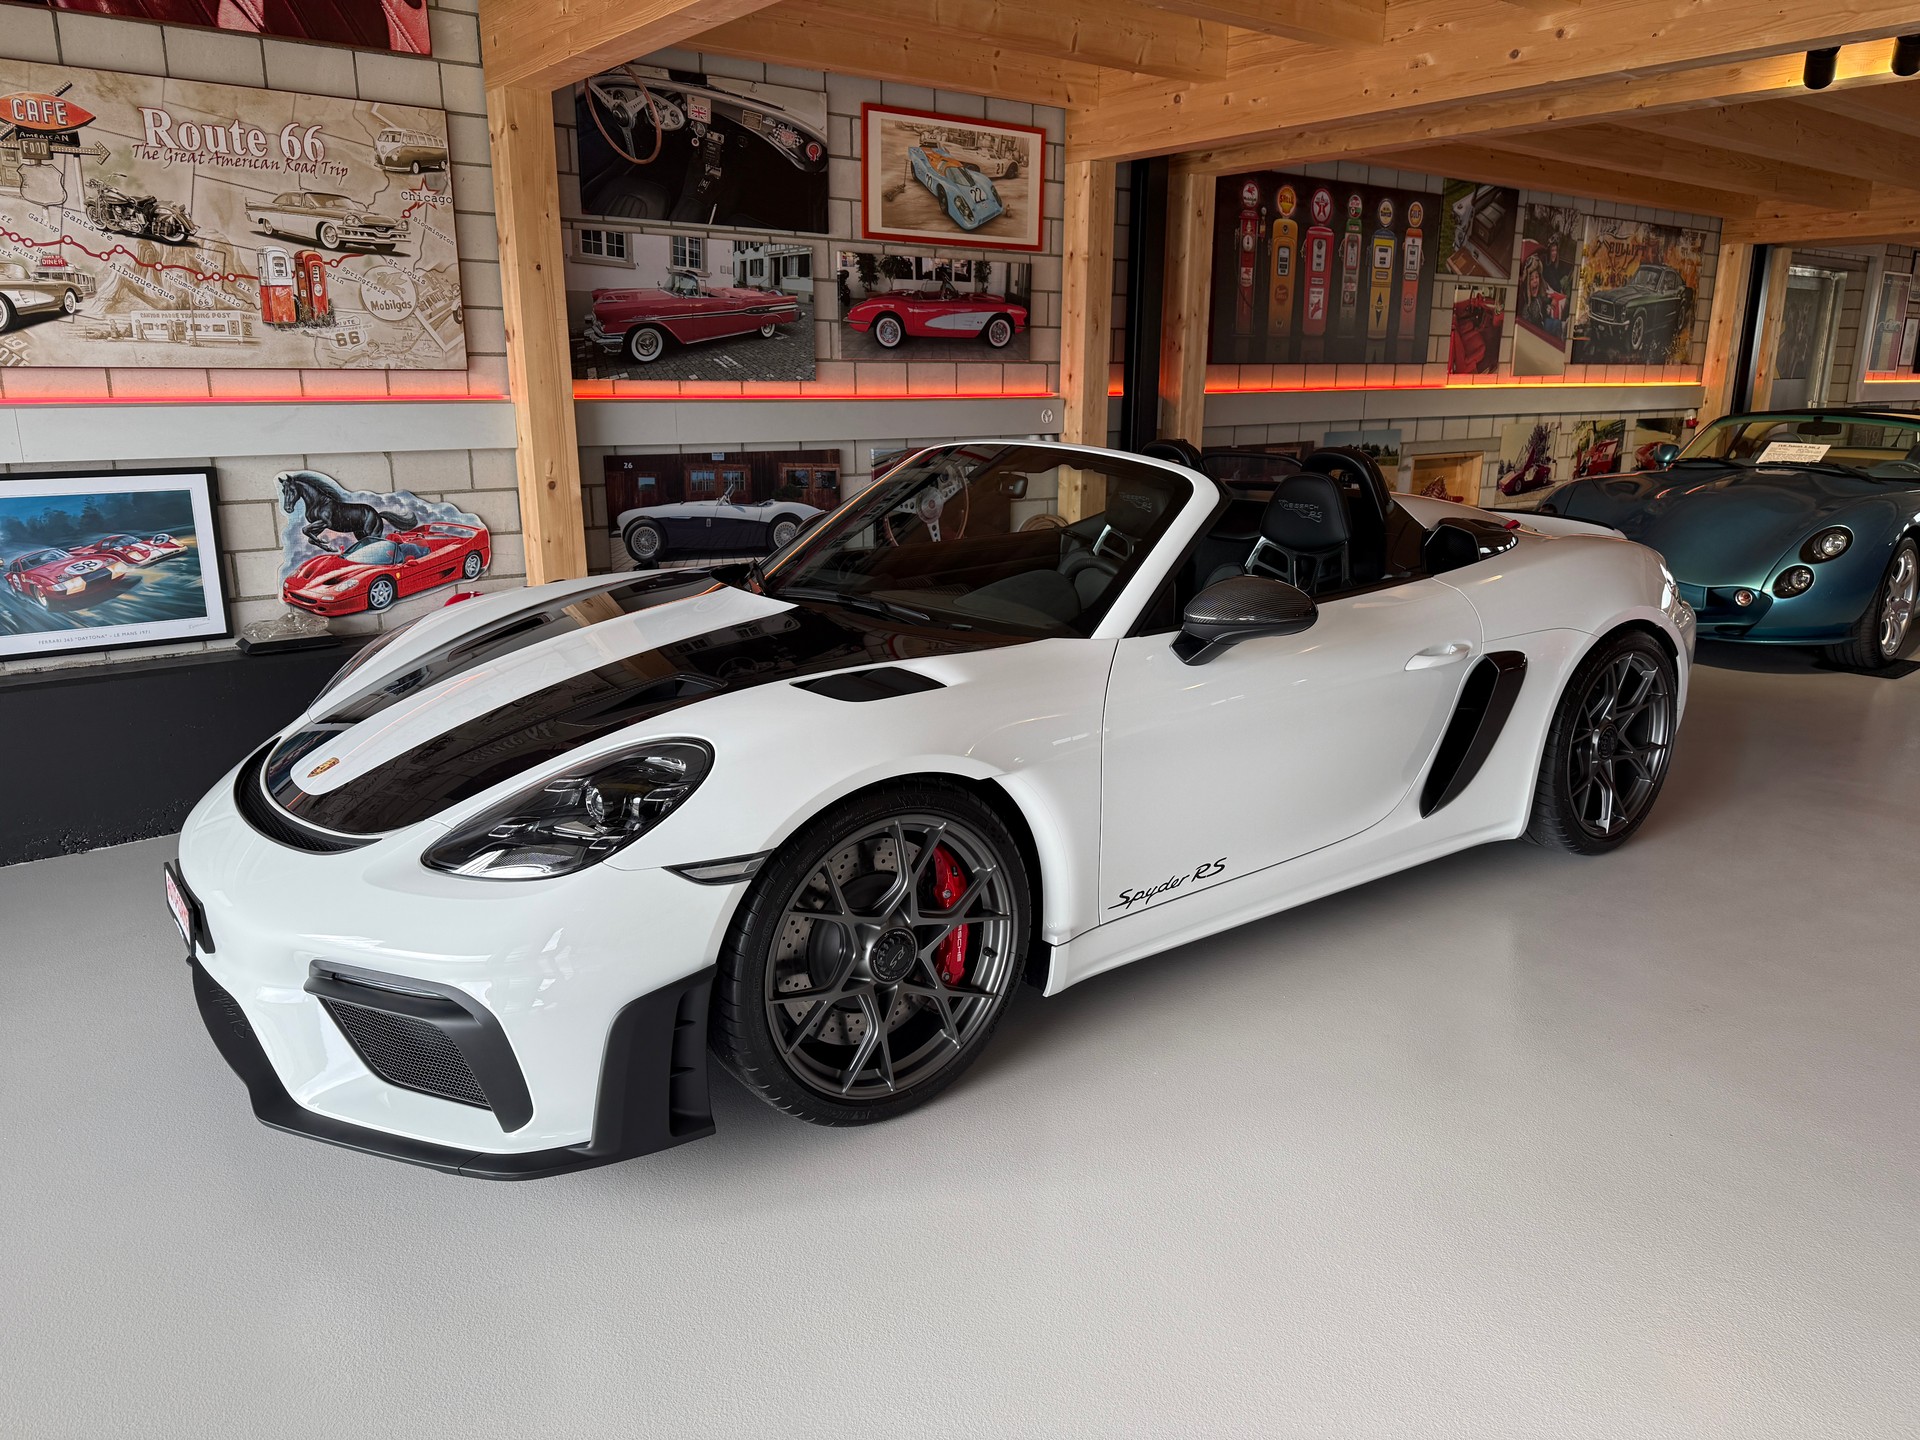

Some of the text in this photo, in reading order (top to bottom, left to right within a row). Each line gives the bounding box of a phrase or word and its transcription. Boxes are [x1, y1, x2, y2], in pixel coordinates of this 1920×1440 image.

[11, 98, 67, 126] CAFE
[19, 131, 70, 142] AMERICAN
[137, 106, 326, 163] Route 66
[22, 140, 48, 155] FOOD
[132, 143, 348, 185] The Great American Road Trip
[400, 191, 453, 205] Chicago
[970, 187, 986, 204] 22
[28, 212, 60, 234] Gallup
[63, 210, 113, 242] Santa Fe
[413, 216, 455, 246] Bloomington
[12, 245, 39, 263] Winsl
[195, 253, 219, 270] Sayre
[109, 262, 176, 301] Albuquerque
[341, 266, 387, 296] Springfield
[387, 258, 427, 285] St Louis
[164, 271, 206, 298] Tucumcari
[204, 284, 241, 308] Amarillo
[236, 281, 252, 294] Elk
[370, 300, 413, 312] Mobilgas
[335, 330, 361, 347] 66
[71, 560, 98, 572] 58
[1107, 857, 1227, 910] Spyder RS
